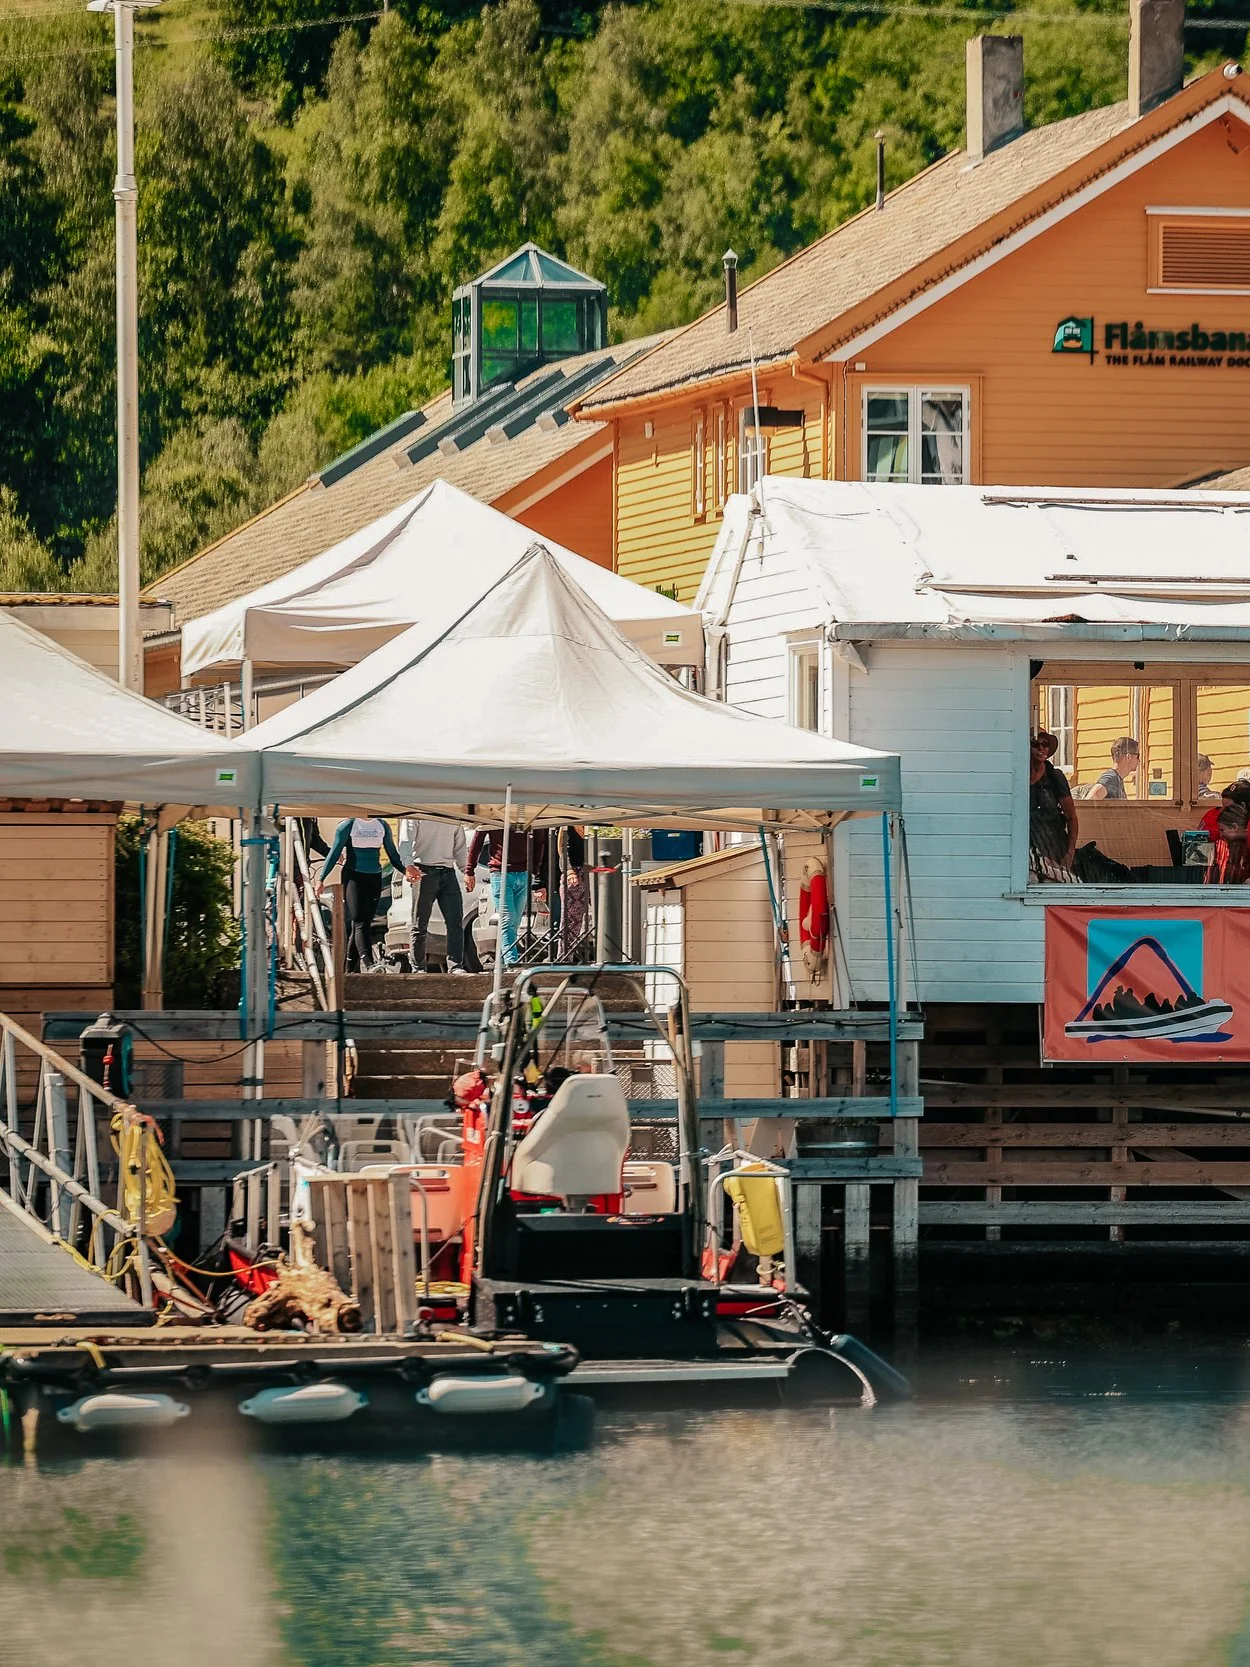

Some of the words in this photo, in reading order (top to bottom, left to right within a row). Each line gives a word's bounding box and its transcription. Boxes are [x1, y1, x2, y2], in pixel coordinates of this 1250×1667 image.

[1105, 354, 1129, 366] THE
[1132, 352, 1165, 366] FLÅM
[1169, 356, 1223, 367] RAILWAY
